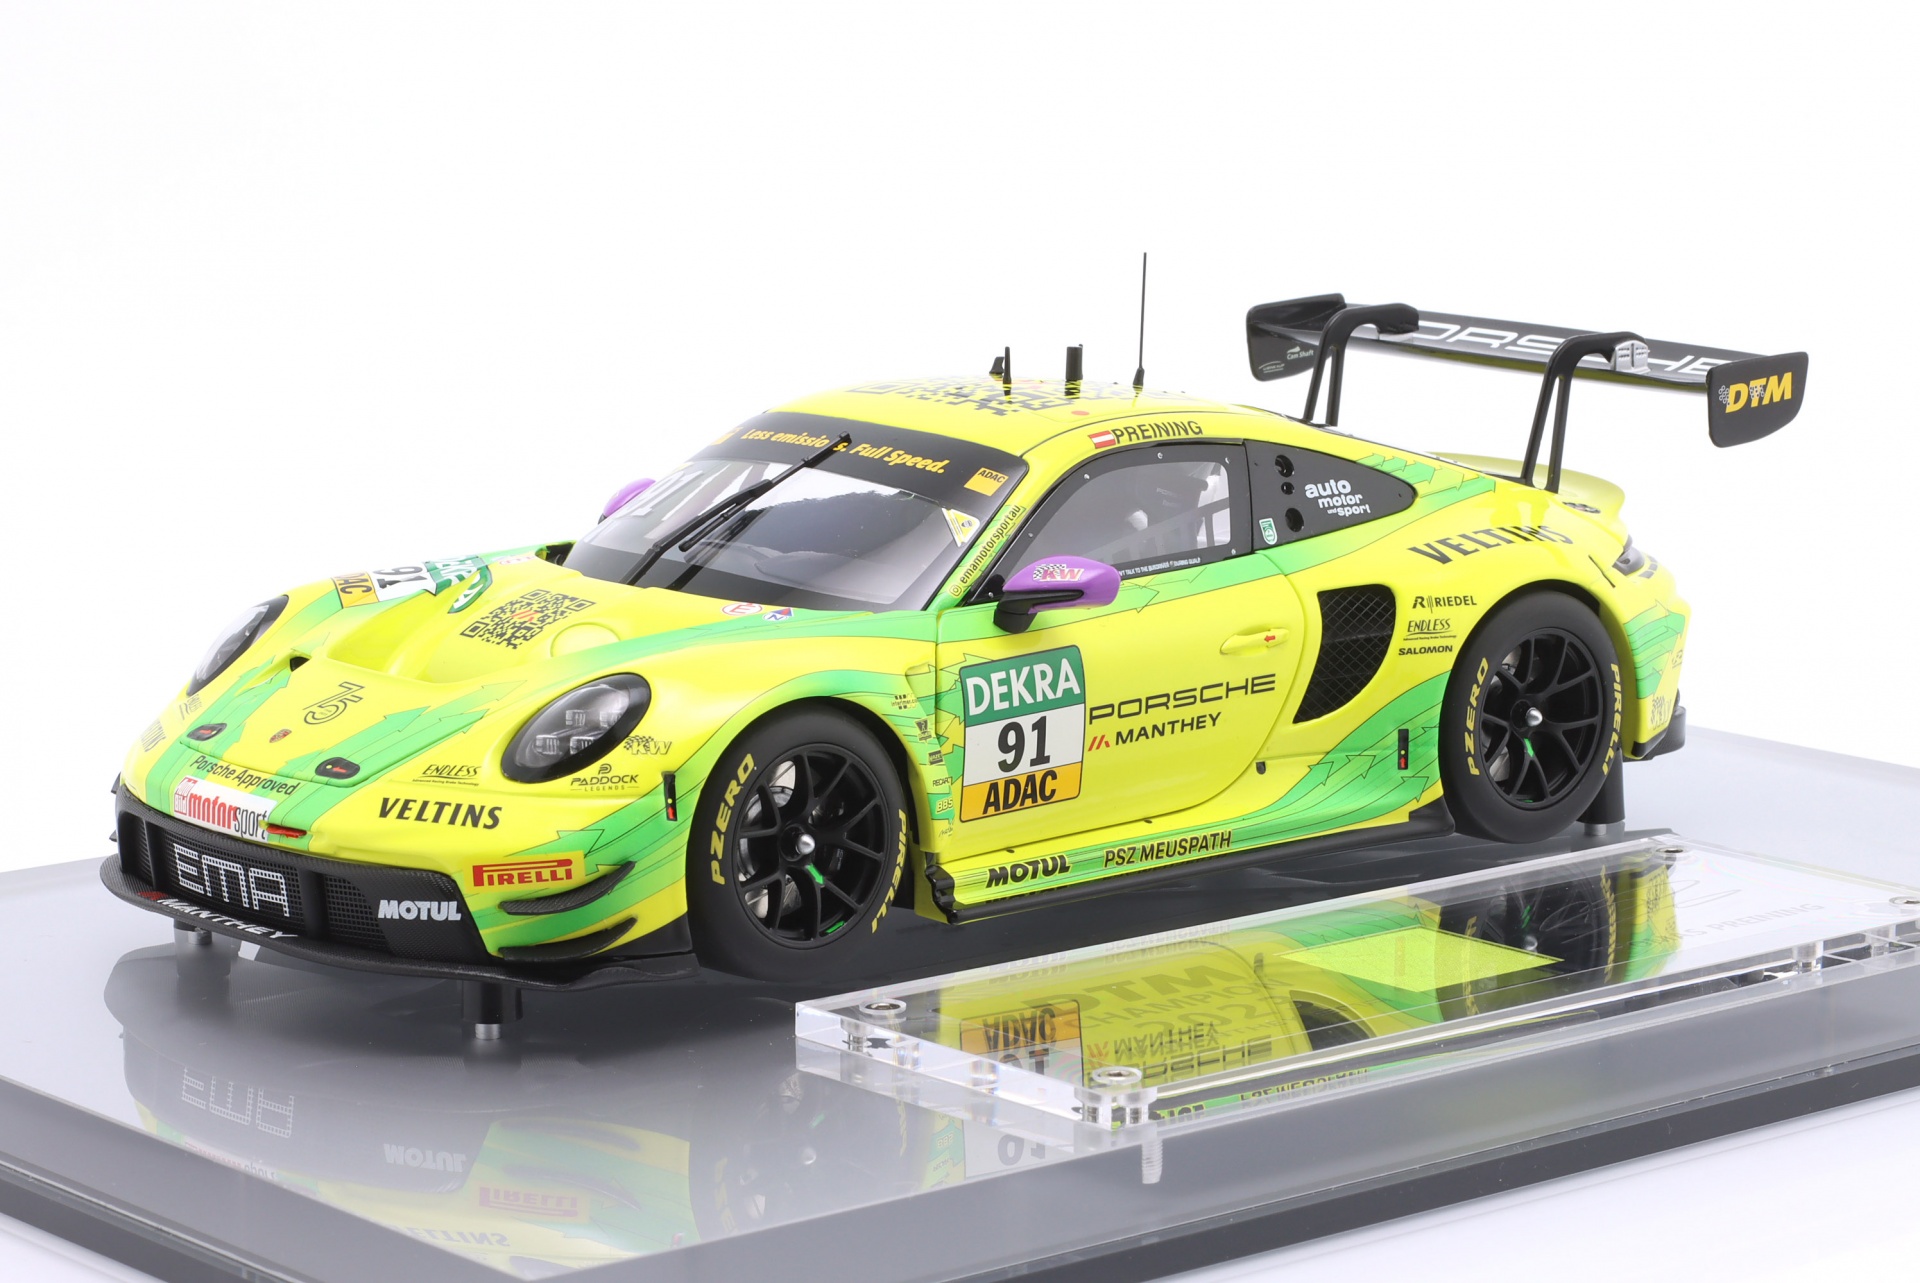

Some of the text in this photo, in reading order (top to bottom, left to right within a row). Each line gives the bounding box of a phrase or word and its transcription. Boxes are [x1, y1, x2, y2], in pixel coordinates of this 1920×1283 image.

[1725, 371, 1792, 414] DTM
[1111, 420, 1203, 444] PREINING
[741, 428, 774, 440] Less
[771, 431, 848, 453] emissios.
[849, 443, 893, 459] Full
[883, 450, 950, 474] Speed.
[977, 469, 1006, 484] ADAC
[1304, 479, 1352, 499] auto
[1318, 493, 1363, 508] motor
[1337, 504, 1371, 517] sport
[1406, 525, 1573, 565] VELTINS
[1435, 595, 1477, 608] RIEDEL
[1407, 618, 1451, 632] ENDLESS
[1398, 645, 1453, 656] SALOMON
[966, 658, 1081, 716] DEKRA
[1089, 673, 1276, 725] PORSCHE
[1115, 712, 1222, 746] MANTHEY
[1601, 663, 1622, 776] PIRELLI
[998, 715, 1051, 773] 91
[190, 755, 300, 796] Porsche Approved
[422, 764, 482, 777] ENDLESS
[570, 774, 640, 786] PADDOCK
[982, 770, 1057, 815] ADAC
[379, 797, 503, 829] VELTINS
[1104, 830, 1233, 868] PSZ MEUSPATH
[173, 843, 290, 917] EMA
[472, 858, 573, 887] PIRELLI
[985, 854, 1071, 888] MOTUL
[156, 898, 299, 939] MANTHEY
[378, 899, 462, 921] MOTUL
[1707, 902, 1825, 931] PREINING
[1022, 965, 1245, 1012] DTM
